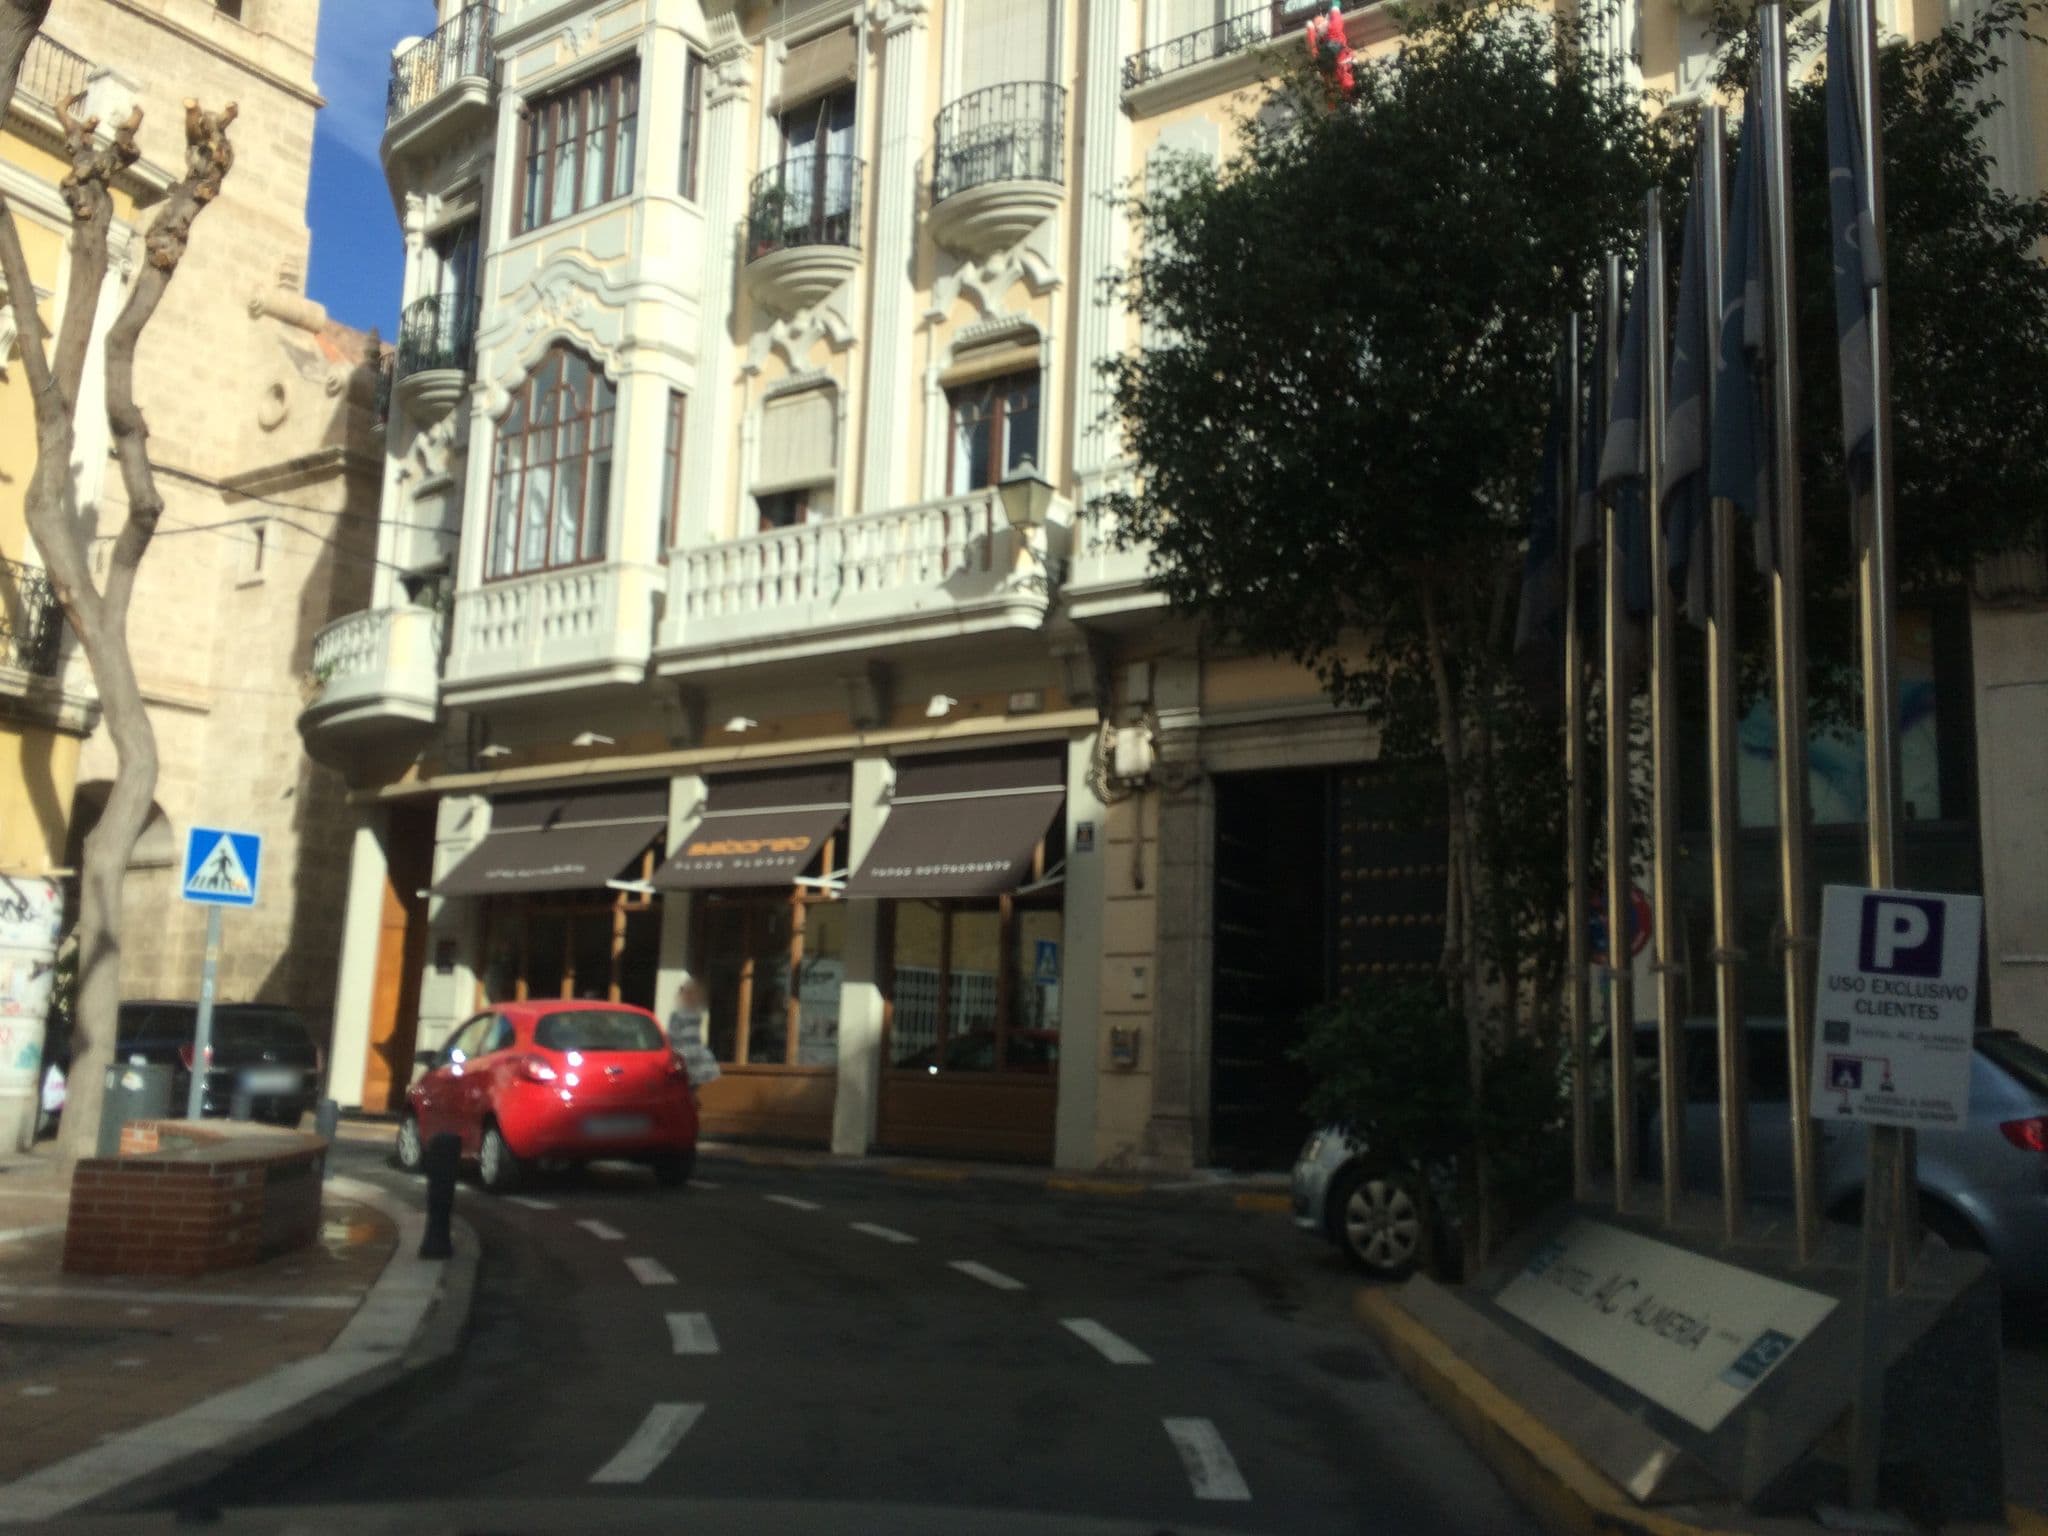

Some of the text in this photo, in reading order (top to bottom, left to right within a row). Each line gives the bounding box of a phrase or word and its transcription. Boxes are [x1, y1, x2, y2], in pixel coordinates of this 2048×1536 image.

[1874, 902, 1930, 968] P
[1828, 974, 1969, 1001] USO EXCLUSIVO
[1855, 998, 1939, 1021] CLIENTES
